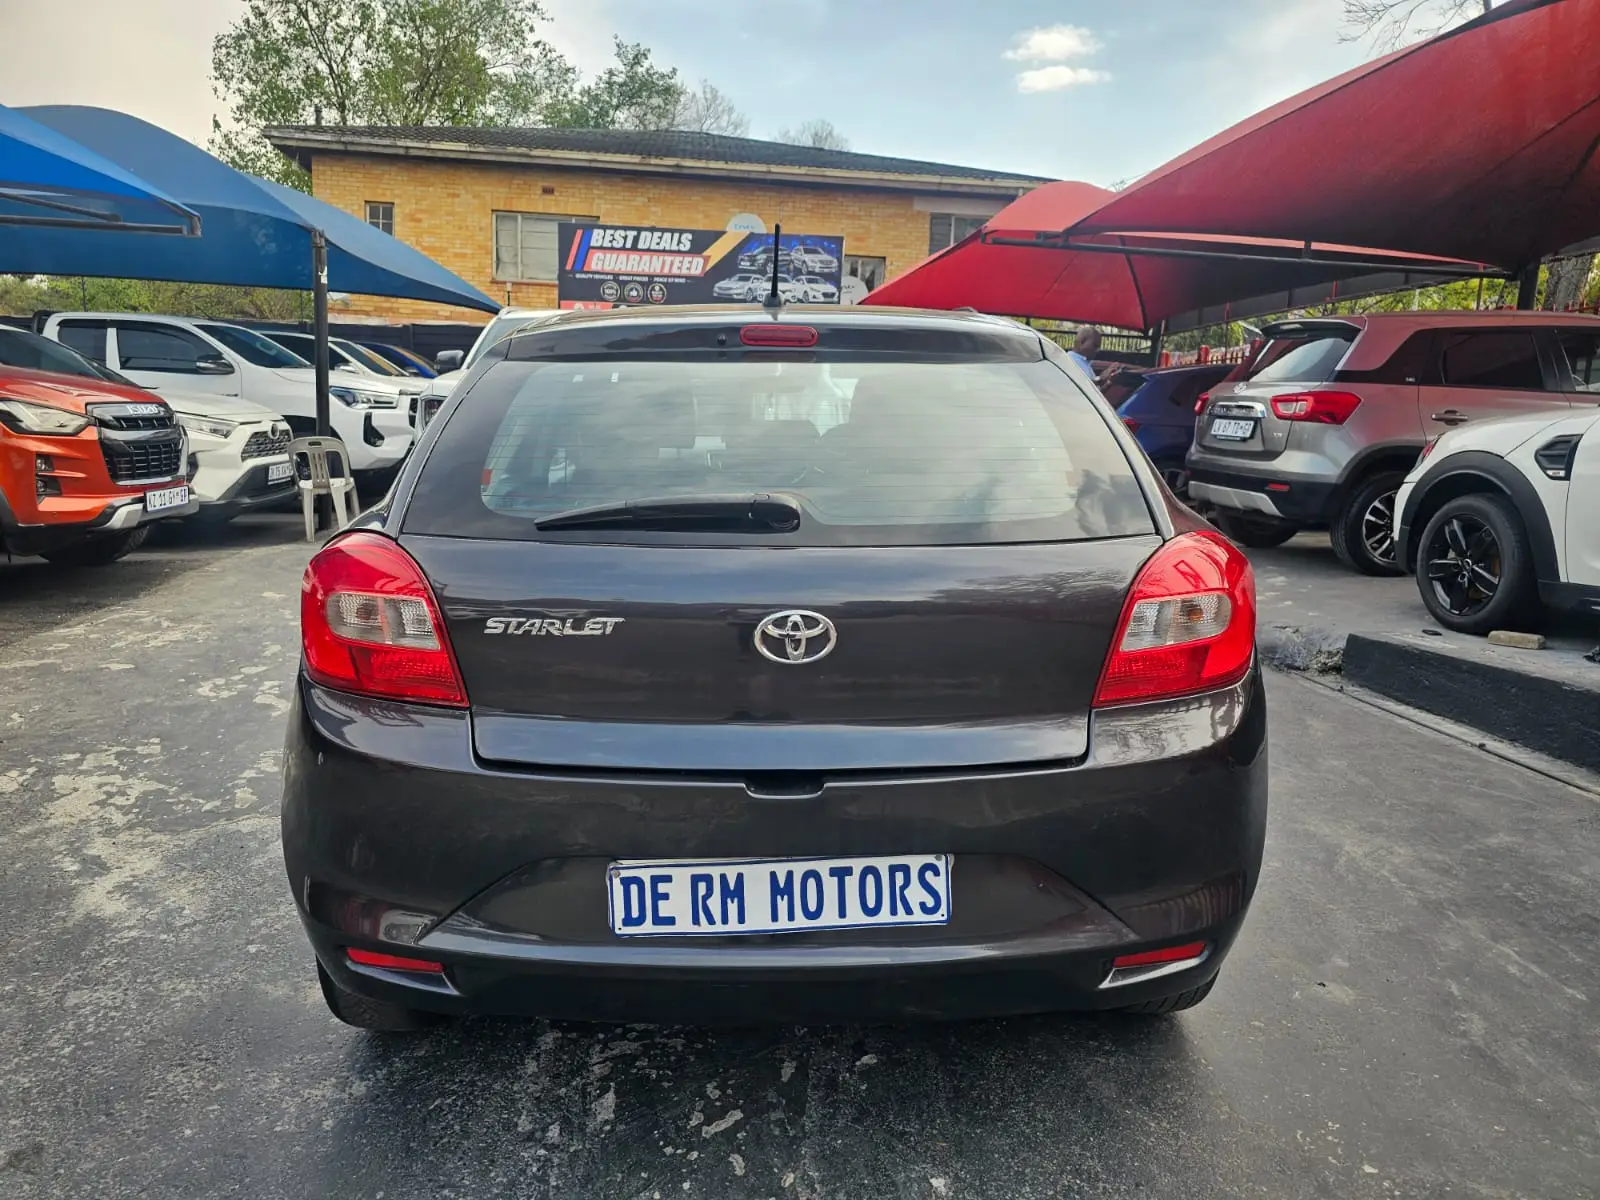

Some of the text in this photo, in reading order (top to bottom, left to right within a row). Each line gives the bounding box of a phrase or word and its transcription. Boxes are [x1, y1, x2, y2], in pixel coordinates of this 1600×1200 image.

[590, 228, 693, 252] BEST DEALS
[590, 252, 705, 276] GUARANTEED
[484, 617, 626, 636] STARLET
[619, 862, 942, 928] DE RM MOTORS
